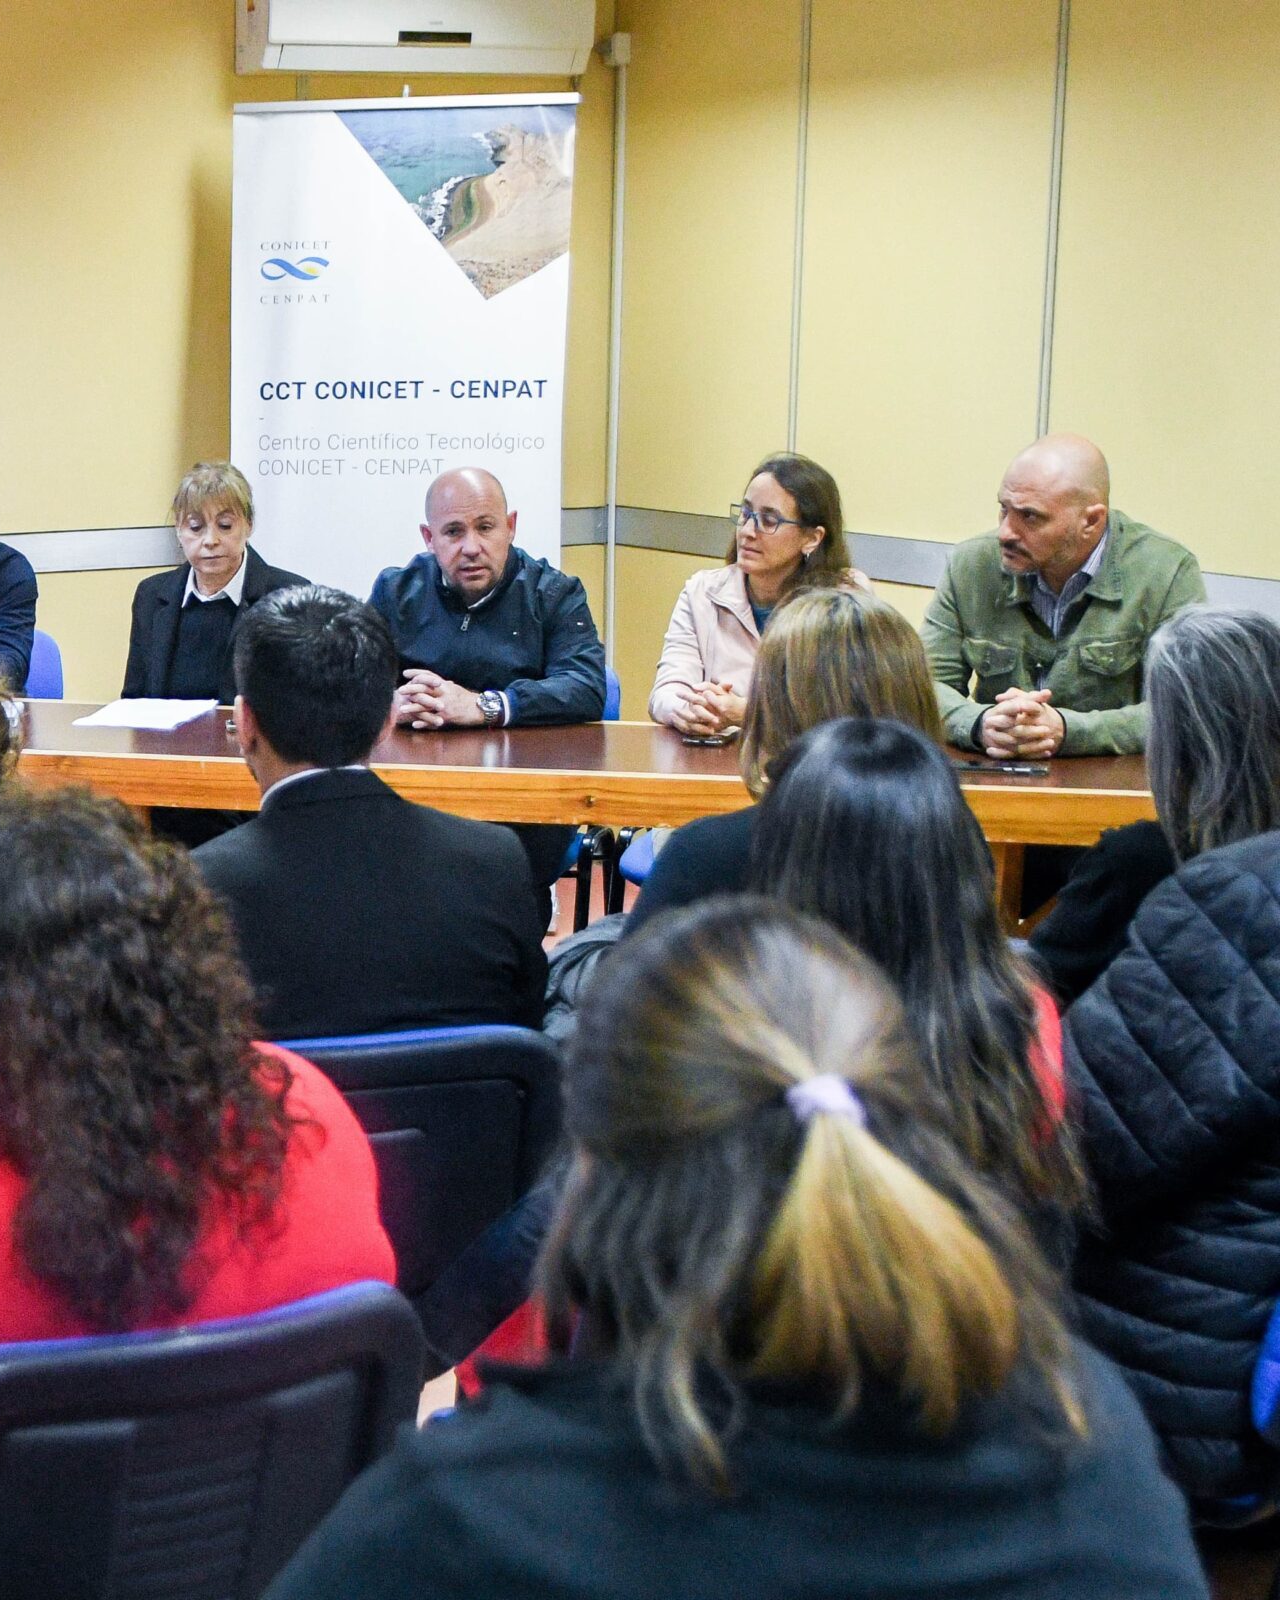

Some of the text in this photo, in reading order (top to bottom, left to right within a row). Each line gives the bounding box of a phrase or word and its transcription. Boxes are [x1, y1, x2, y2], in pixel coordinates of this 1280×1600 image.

[260, 241, 331, 251] CONICET
[260, 293, 330, 304] CENPAT
[259, 381, 307, 400] CCT
[315, 380, 424, 400] CONICET
[450, 379, 548, 399] CENPAT
[258, 432, 545, 454] Centro Científico Tecnológico
[258, 458, 345, 476] CONICET
[365, 458, 445, 476] CENPAT
